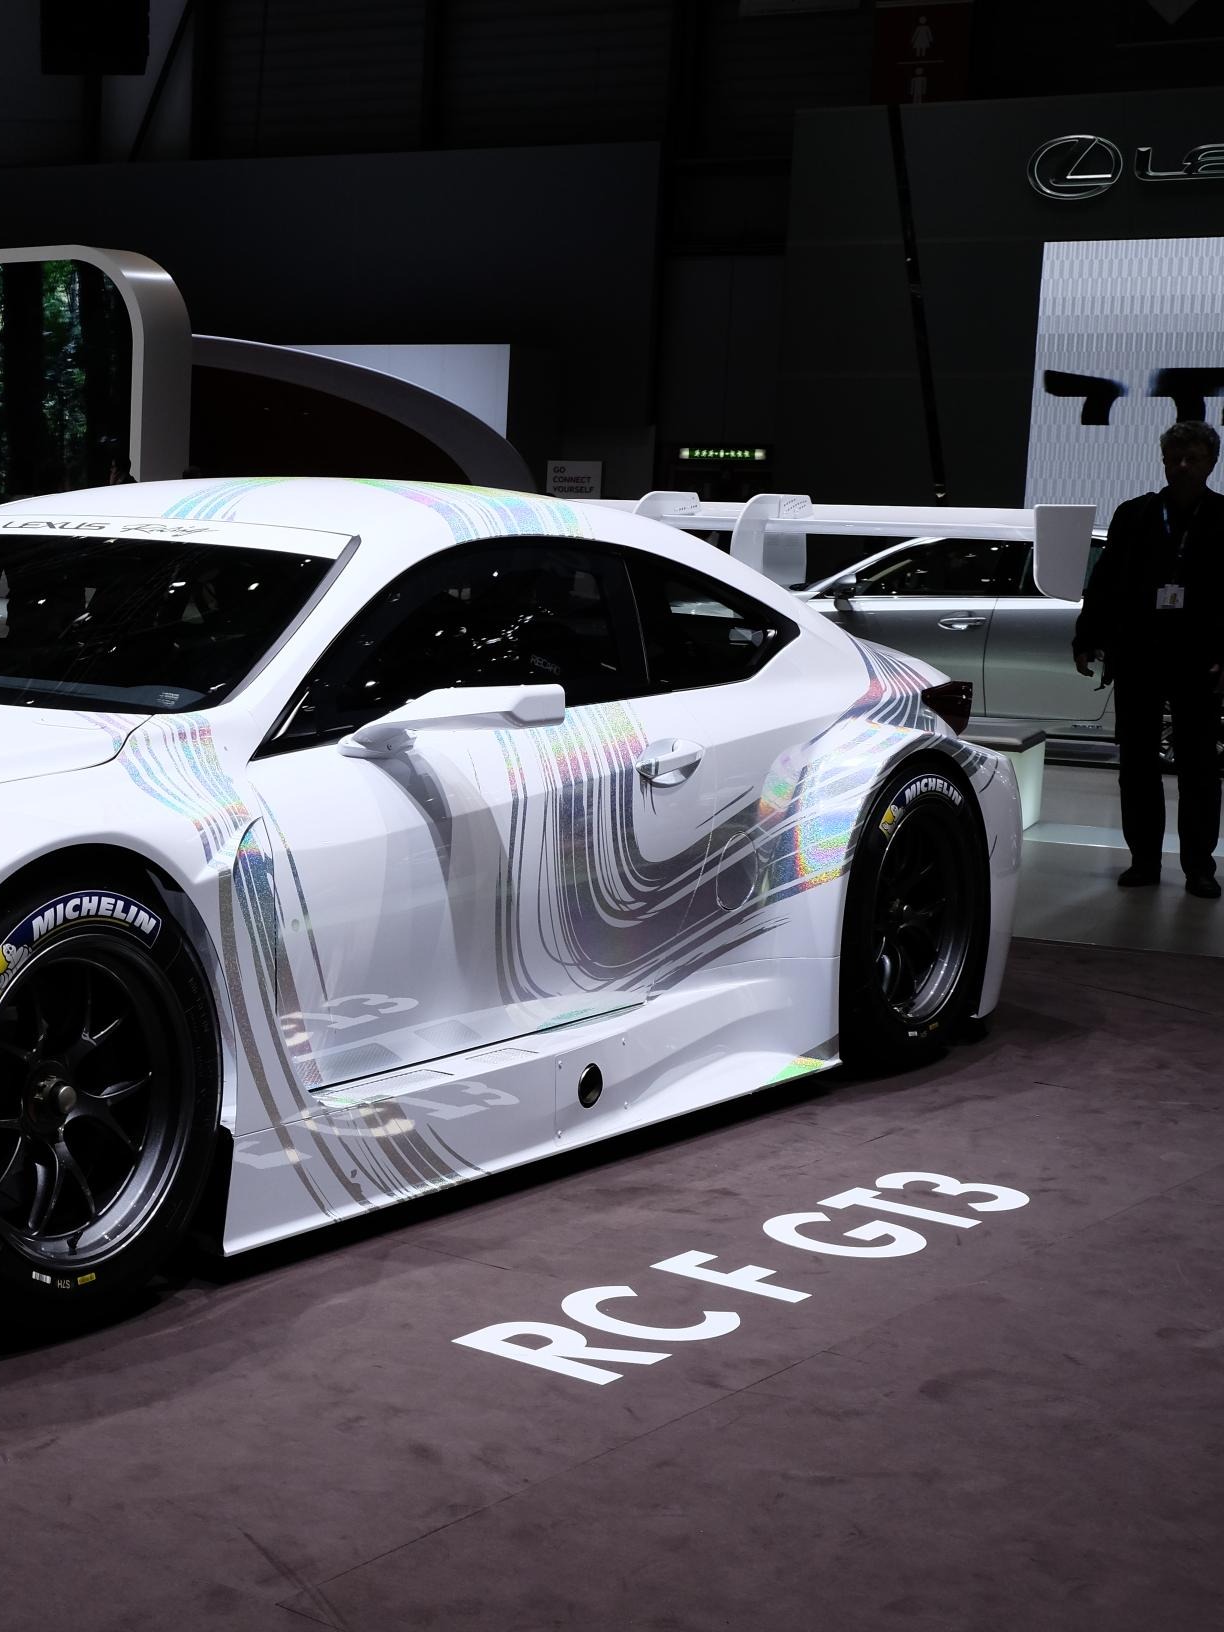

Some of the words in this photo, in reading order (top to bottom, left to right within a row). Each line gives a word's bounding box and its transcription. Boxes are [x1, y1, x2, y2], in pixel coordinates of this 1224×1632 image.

[552, 475, 592, 484] CONNECT
[552, 486, 594, 494] YOURSELF
[3, 521, 110, 531] LEXUS
[905, 777, 962, 806] MICHELIN
[32, 896, 157, 942] MICHELIN
[450, 1285, 741, 1386] RC
[649, 1249, 813, 1304] F
[762, 1171, 1030, 1258] GT3
